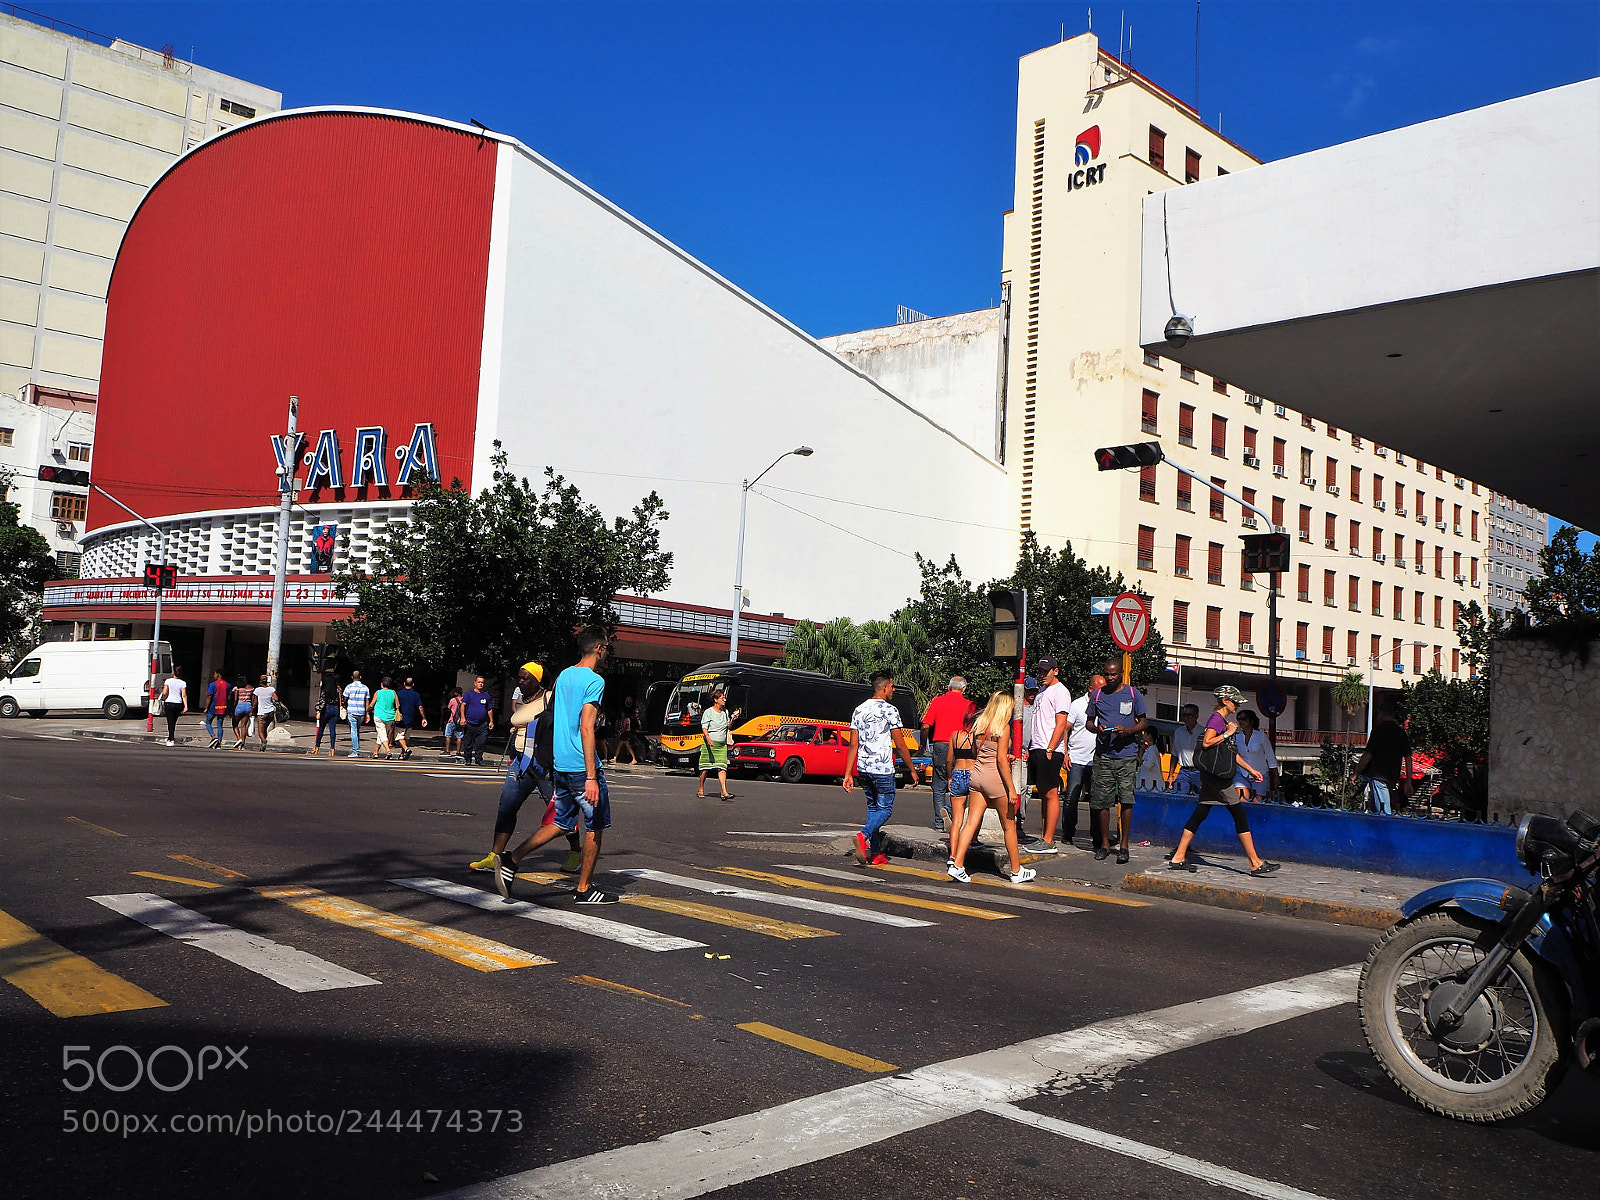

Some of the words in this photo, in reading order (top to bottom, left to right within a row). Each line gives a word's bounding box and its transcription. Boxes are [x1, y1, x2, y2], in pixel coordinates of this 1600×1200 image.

[1067, 162, 1107, 193] ICRT
[146, 566, 176, 587] 47
[217, 589, 253, 599] TALISMAN
[258, 589, 291, 599] SABO
[296, 588, 309, 600] 23
[1121, 613, 1137, 623] PARE
